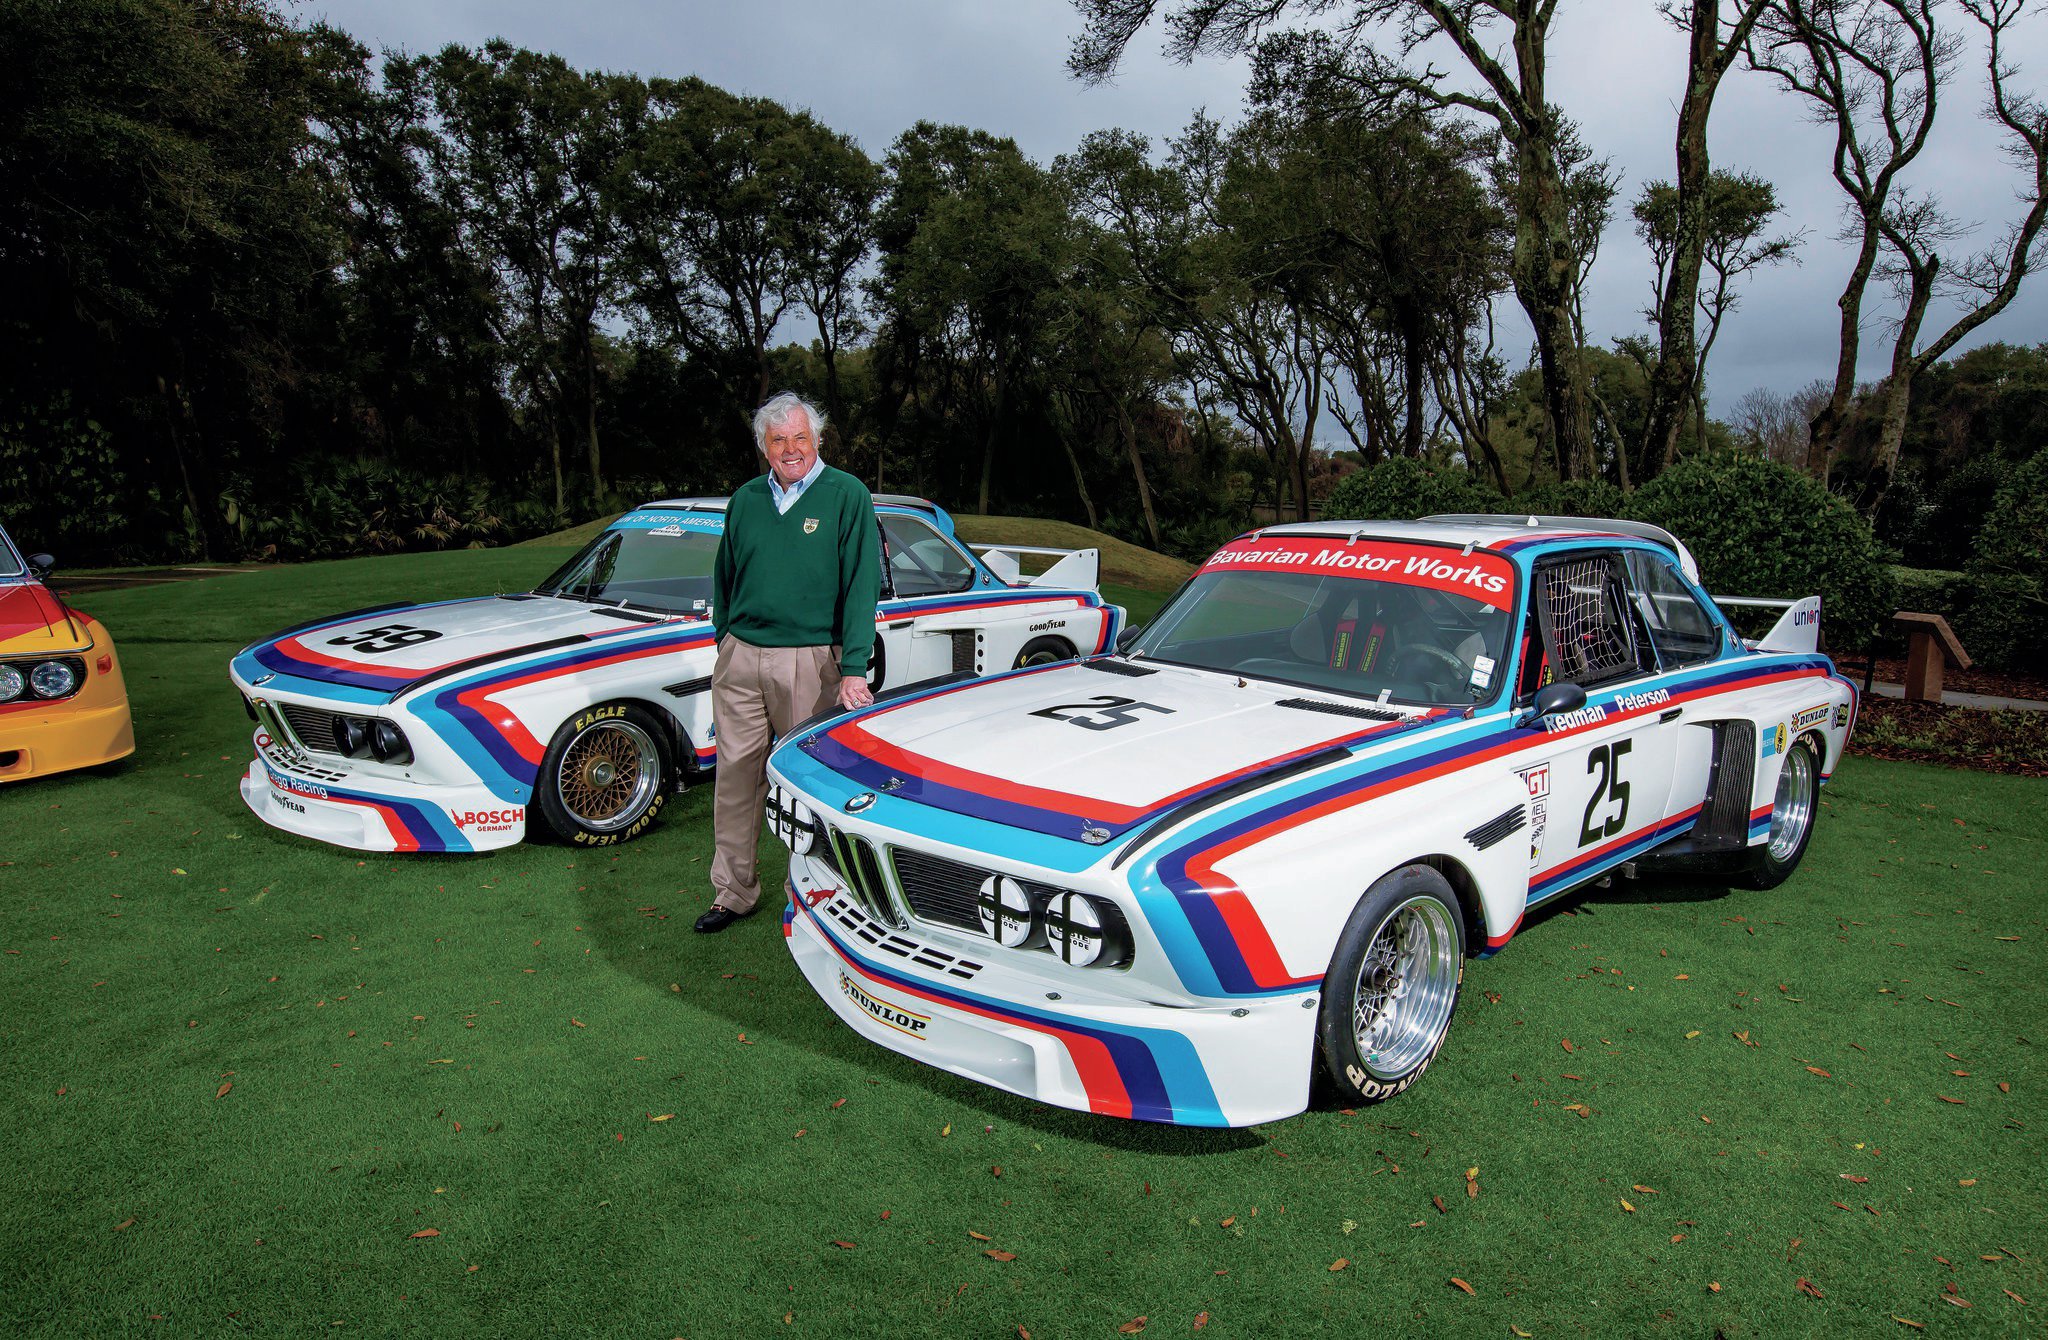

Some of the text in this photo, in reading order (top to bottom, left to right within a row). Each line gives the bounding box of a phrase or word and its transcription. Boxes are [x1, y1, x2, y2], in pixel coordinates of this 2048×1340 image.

[633, 515, 649, 523] OF
[647, 515, 682, 524] NORTH
[680, 517, 725, 528] AMERICA
[1206, 547, 1506, 593] Bavarian Motor Works
[326, 624, 444, 654] 59
[575, 706, 627, 732] EAGLE
[1028, 695, 1177, 731] 25
[1543, 688, 1671, 735] Redman Peterson
[1799, 707, 1829, 726] DUNLOP
[290, 777, 328, 800] Racing
[1528, 768, 1548, 795] GT
[1578, 738, 1632, 848] 25
[464, 808, 525, 825] BOSCH
[1001, 921, 1019, 932] ODE
[1070, 939, 1089, 951] ODE
[850, 986, 926, 1032] DUNLOP
